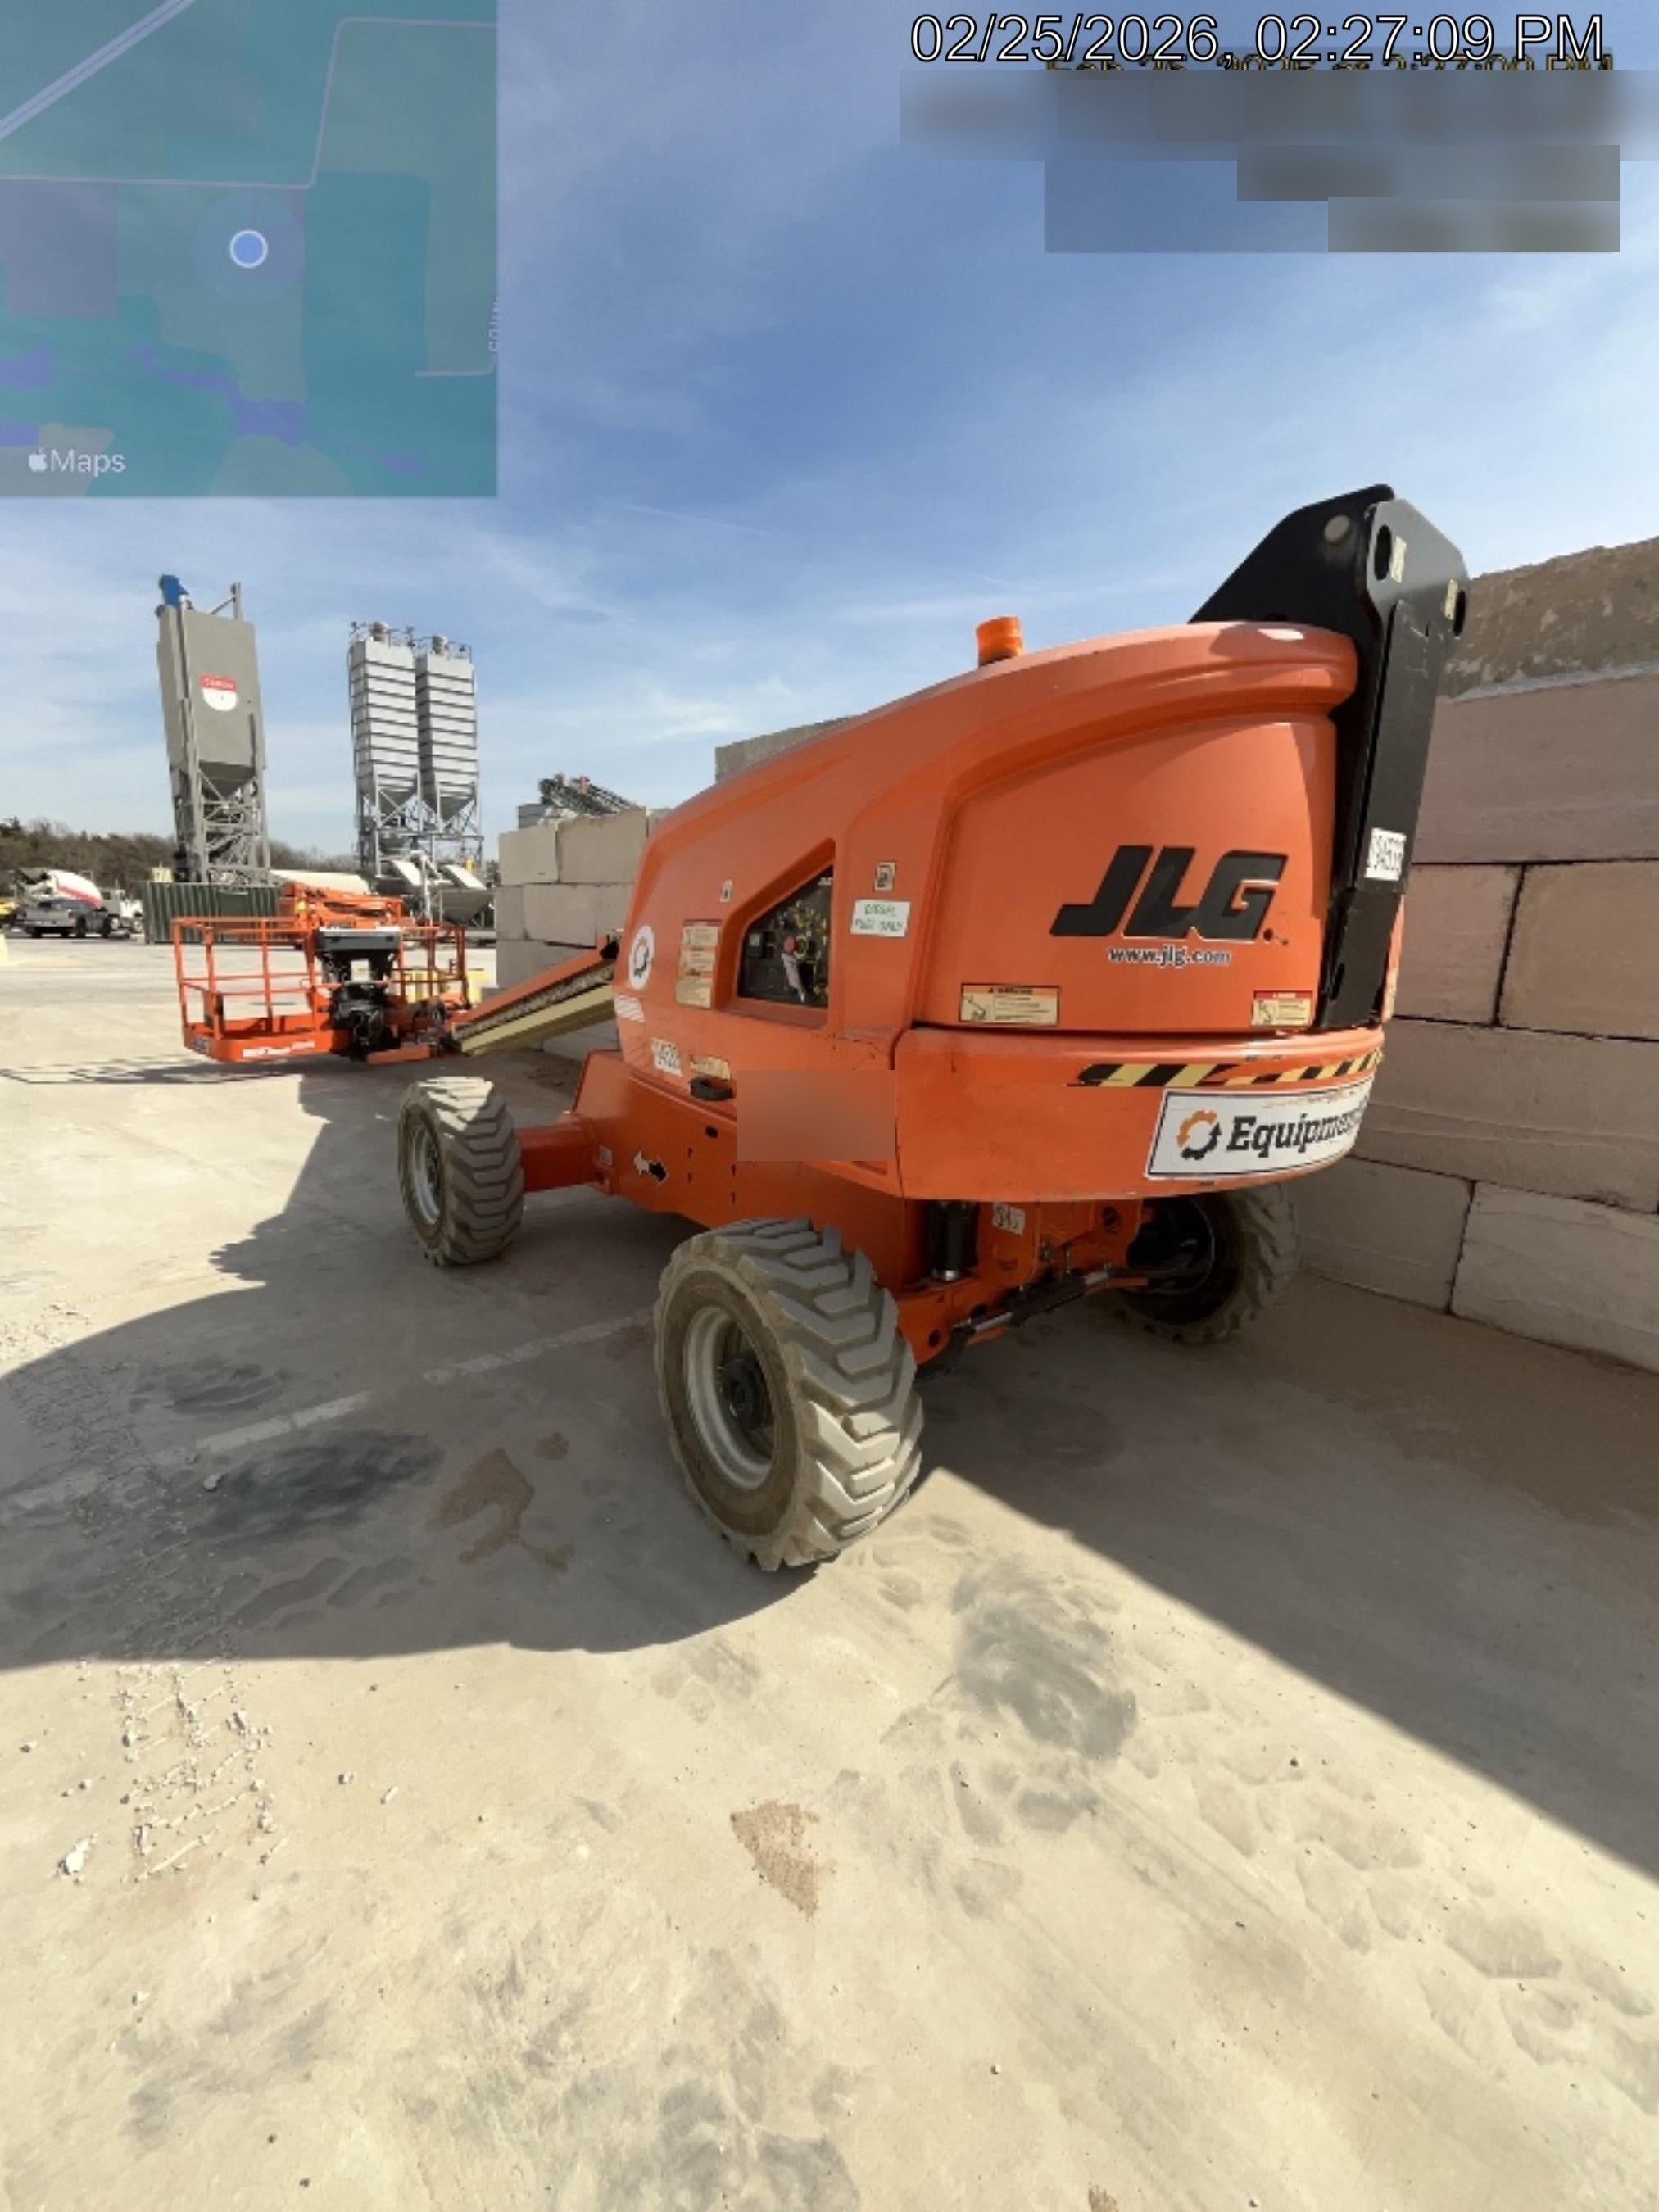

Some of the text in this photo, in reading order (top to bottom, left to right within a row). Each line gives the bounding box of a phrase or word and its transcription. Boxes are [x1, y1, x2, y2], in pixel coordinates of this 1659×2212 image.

[1049, 845, 1289, 942] JLG
[1108, 944, 1231, 968] www.jlg.com
[1226, 1102, 1360, 1158] Equipme
